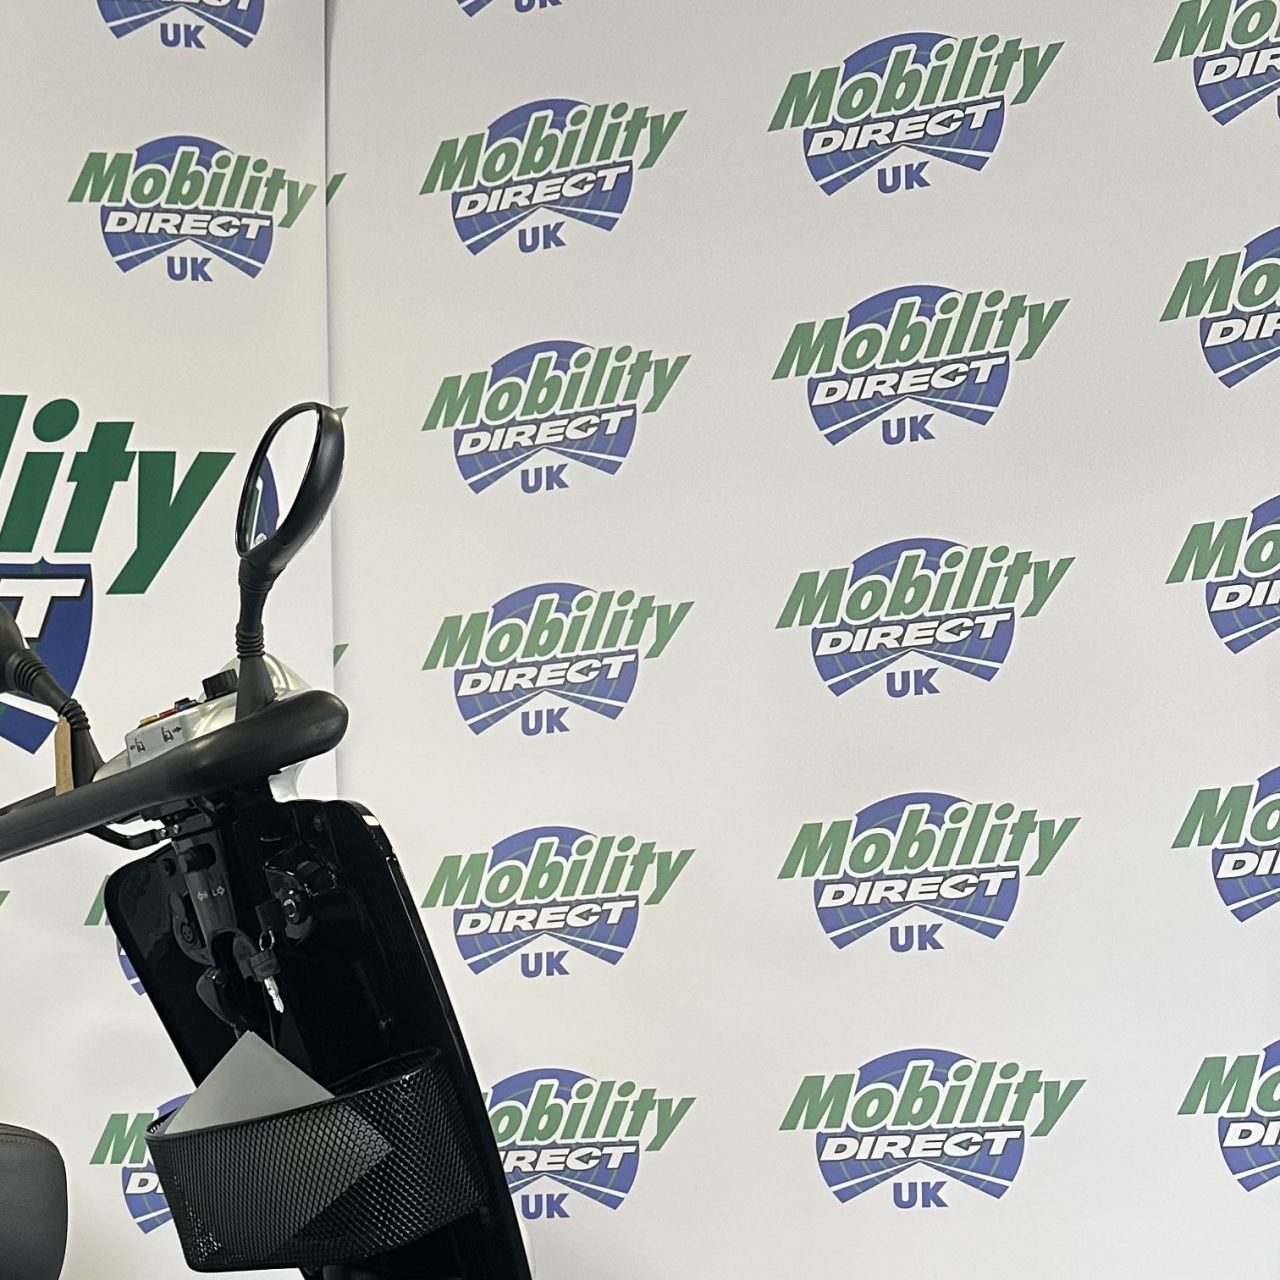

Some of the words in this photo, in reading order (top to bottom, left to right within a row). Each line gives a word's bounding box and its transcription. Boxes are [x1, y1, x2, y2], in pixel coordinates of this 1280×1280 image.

[160, 24, 206, 50] UK
[767, 34, 1065, 133] Mobility
[419, 101, 687, 195] Mobility
[807, 101, 1001, 157] DIRECT
[68, 151, 317, 229] Mobility
[455, 166, 631, 218] DIRECT
[877, 161, 931, 193] UK
[104, 212, 270, 239] DIRECT
[518, 222, 566, 253] UK
[167, 256, 213, 282] UK
[771, 290, 1070, 380] Mobility
[421, 344, 691, 432] Mobility
[812, 356, 1007, 406] DIRECT
[458, 410, 634, 455] DIRECT
[882, 414, 936, 445] UK
[519, 463, 569, 494] UK
[775, 545, 1076, 629] Mobility
[422, 589, 695, 671] Mobility
[816, 612, 1011, 655] DIRECT
[457, 656, 635, 696] DIRECT
[886, 667, 940, 698] UK
[521, 706, 570, 736] UK
[777, 803, 1081, 879] Mobility
[423, 834, 695, 906] Mobility
[818, 870, 1017, 908] DIRECT
[457, 904, 636, 935] DIRECT
[889, 924, 944, 952] UK
[521, 951, 570, 978] UK
[482, 1080, 697, 1151] obility
[779, 1061, 1086, 1137] Mobility
[820, 1130, 1021, 1161] DIRECT
[521, 1193, 570, 1220] UK
[893, 1181, 948, 1209] UK
